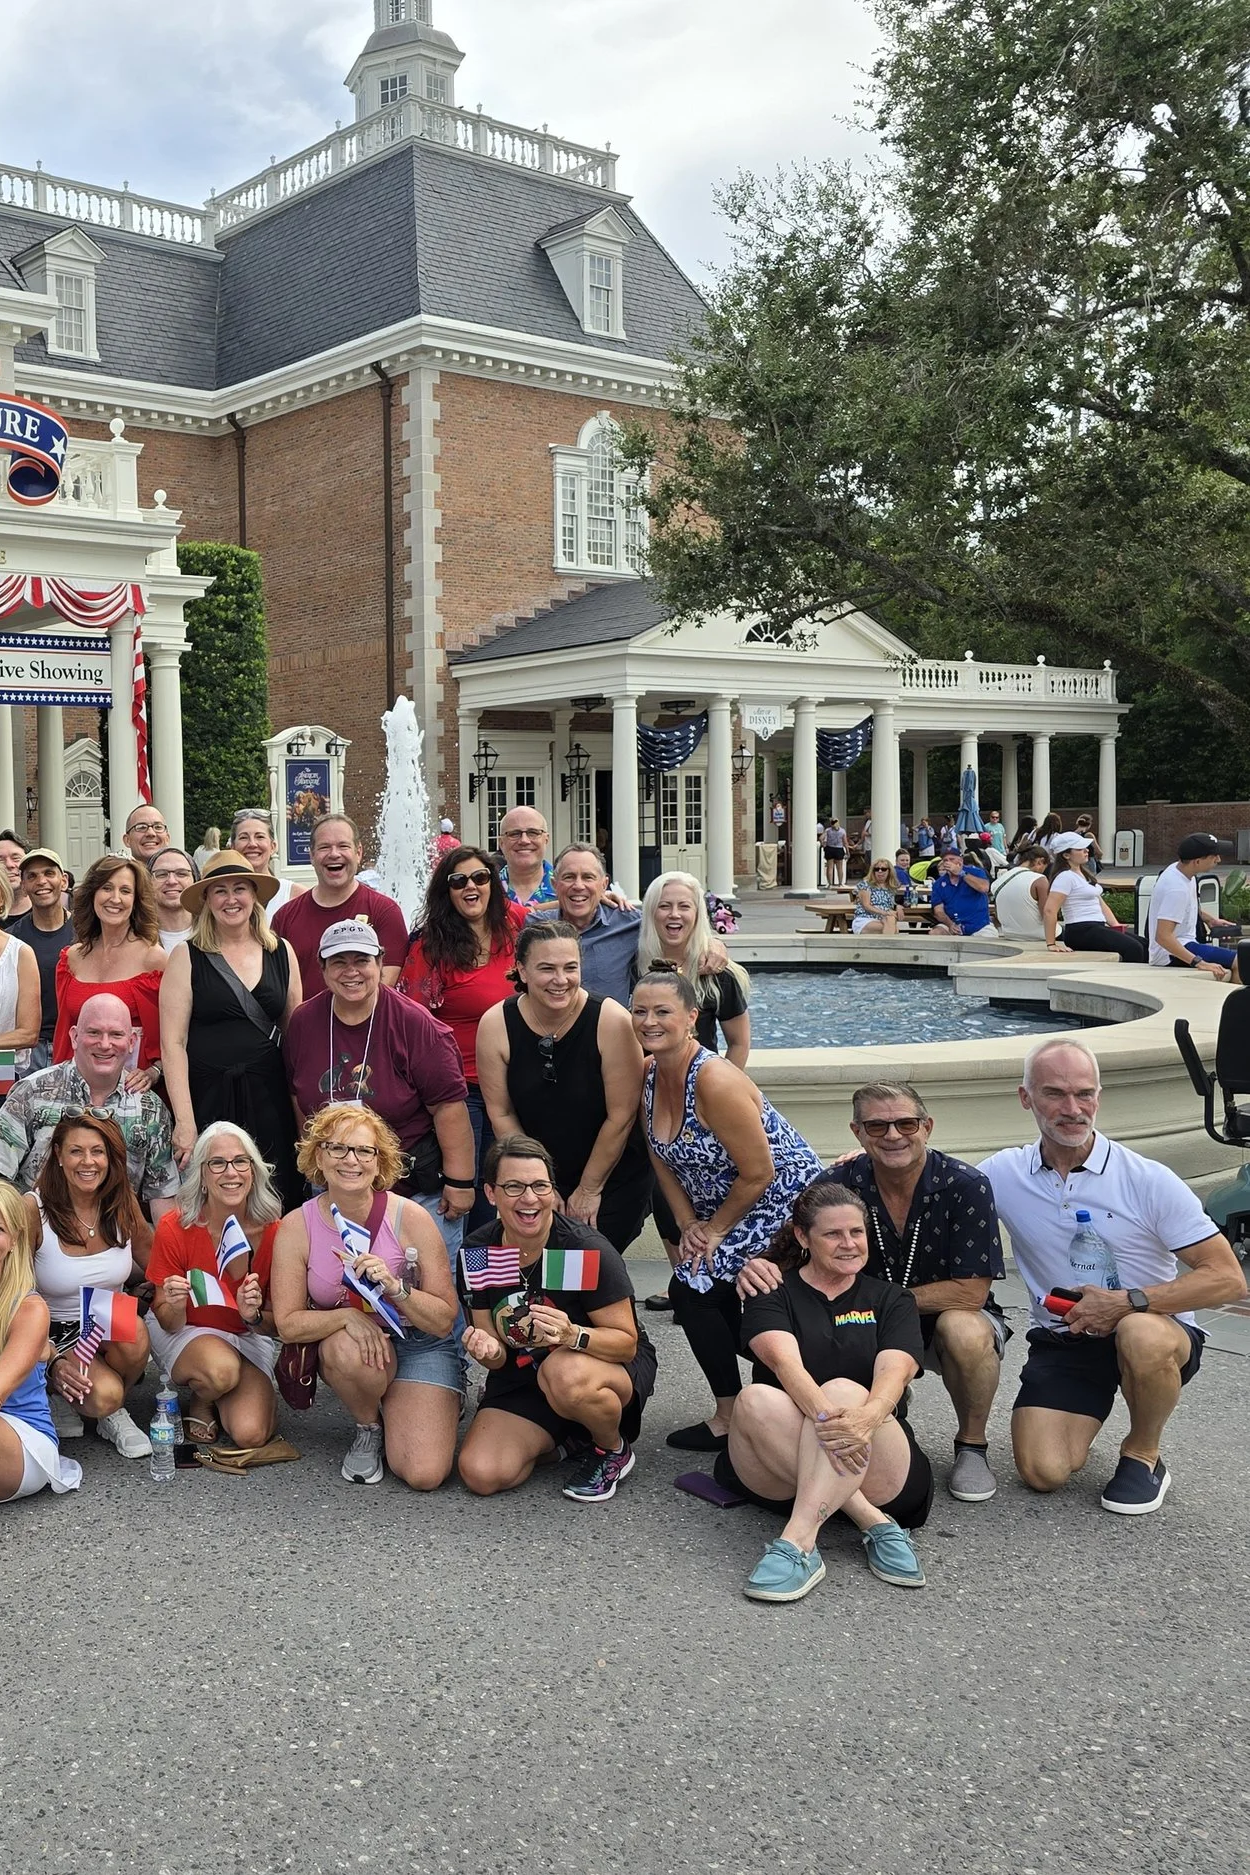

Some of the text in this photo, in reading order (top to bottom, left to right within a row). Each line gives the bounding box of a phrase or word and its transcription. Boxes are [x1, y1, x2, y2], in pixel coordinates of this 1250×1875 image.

[29, 660, 104, 685] Showing
[749, 715, 777, 725] DISNEY
[834, 1310, 877, 1327] MARVEL
